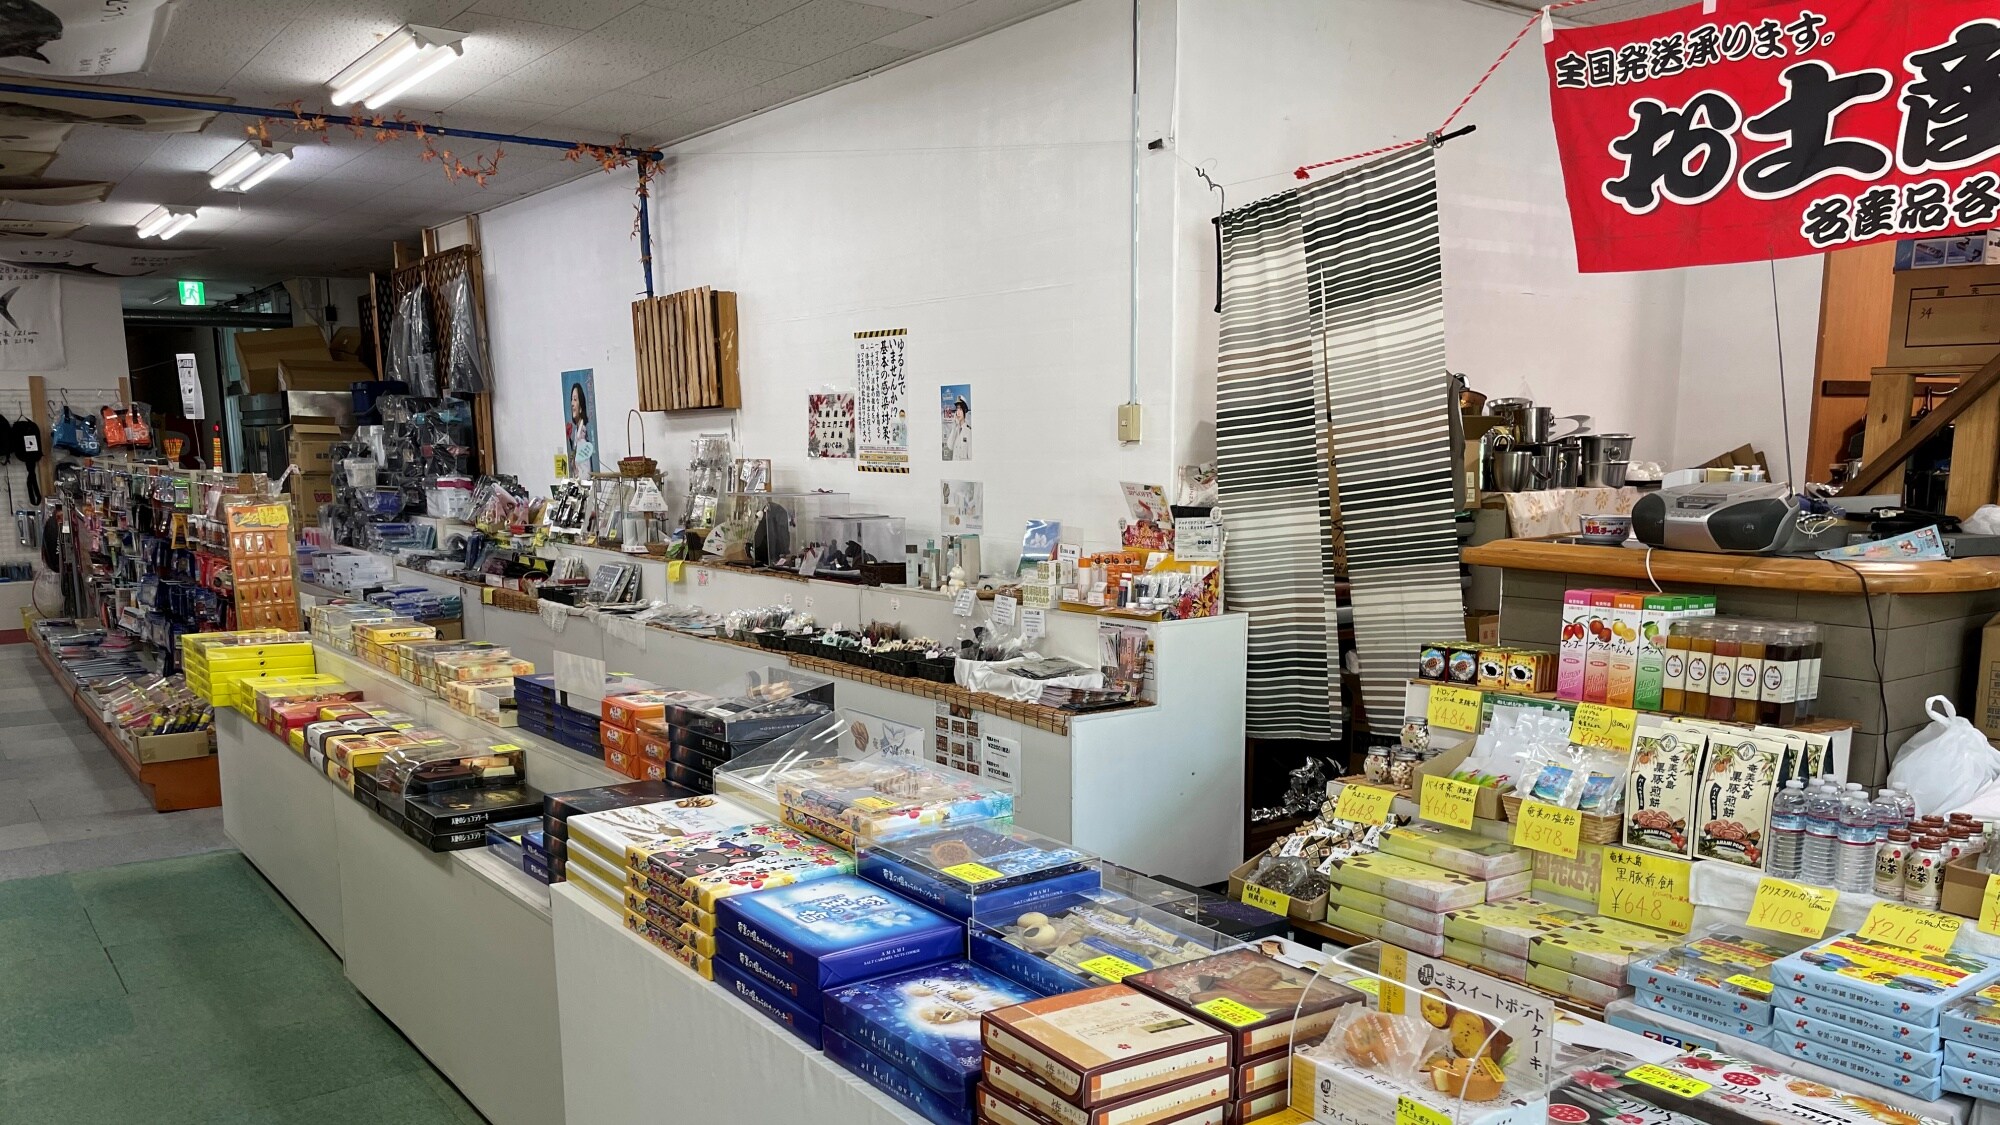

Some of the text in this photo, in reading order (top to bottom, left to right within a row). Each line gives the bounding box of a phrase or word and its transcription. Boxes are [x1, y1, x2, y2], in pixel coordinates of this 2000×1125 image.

[1556, 11, 1835, 89] 全国発送承ります。
[898, 338, 906, 395] ゆるんで
[1340, 798, 1375, 821] ¥648
[1425, 795, 1458, 820] ¥648
[1527, 805, 1576, 826] 奄美の塩飴
[1523, 821, 1563, 847] ¥378
[1610, 852, 1642, 868] 奄美大島
[1611, 888, 1663, 921] ¥648
[1759, 902, 1804, 928] ¥108
[1868, 915, 1921, 944] ¥216
[881, 946, 906, 957] AMAMI
